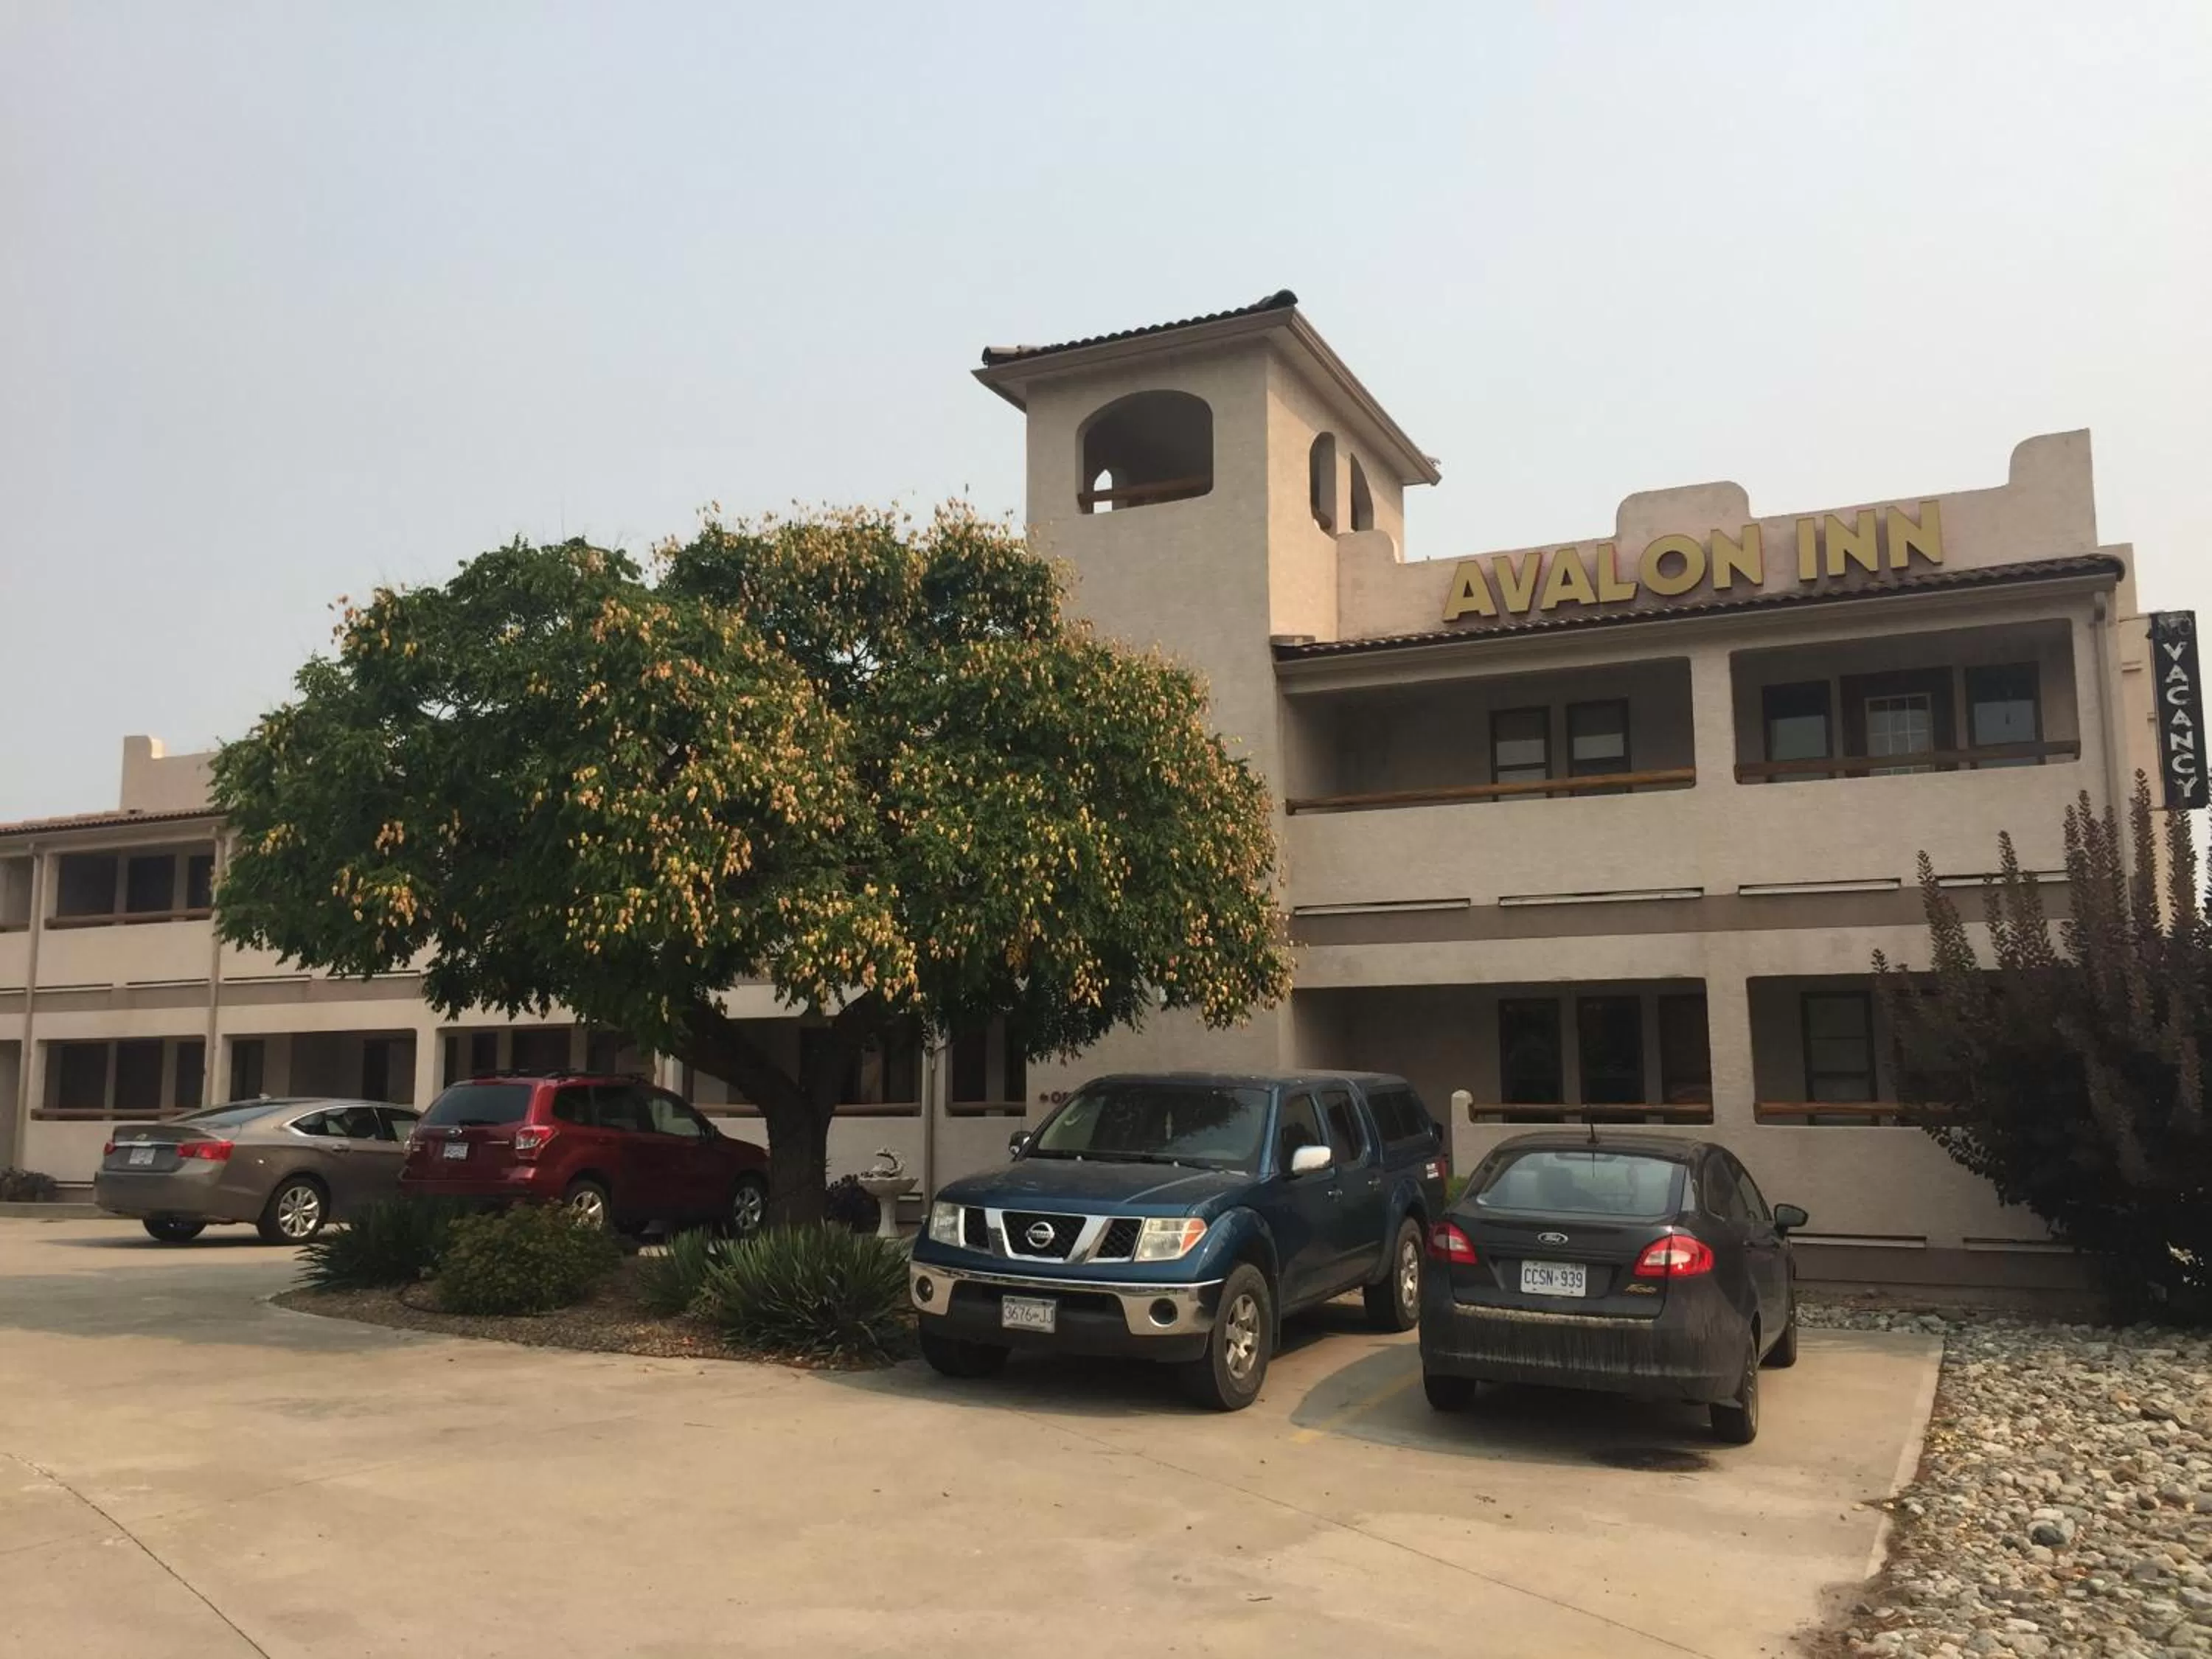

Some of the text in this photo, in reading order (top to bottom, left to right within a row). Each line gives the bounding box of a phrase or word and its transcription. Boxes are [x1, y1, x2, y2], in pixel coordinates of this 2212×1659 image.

[1441, 501, 1943, 622] AVALON INN
[2162, 641, 2199, 798] VACANCY
[1560, 1270, 1583, 1288] 939
